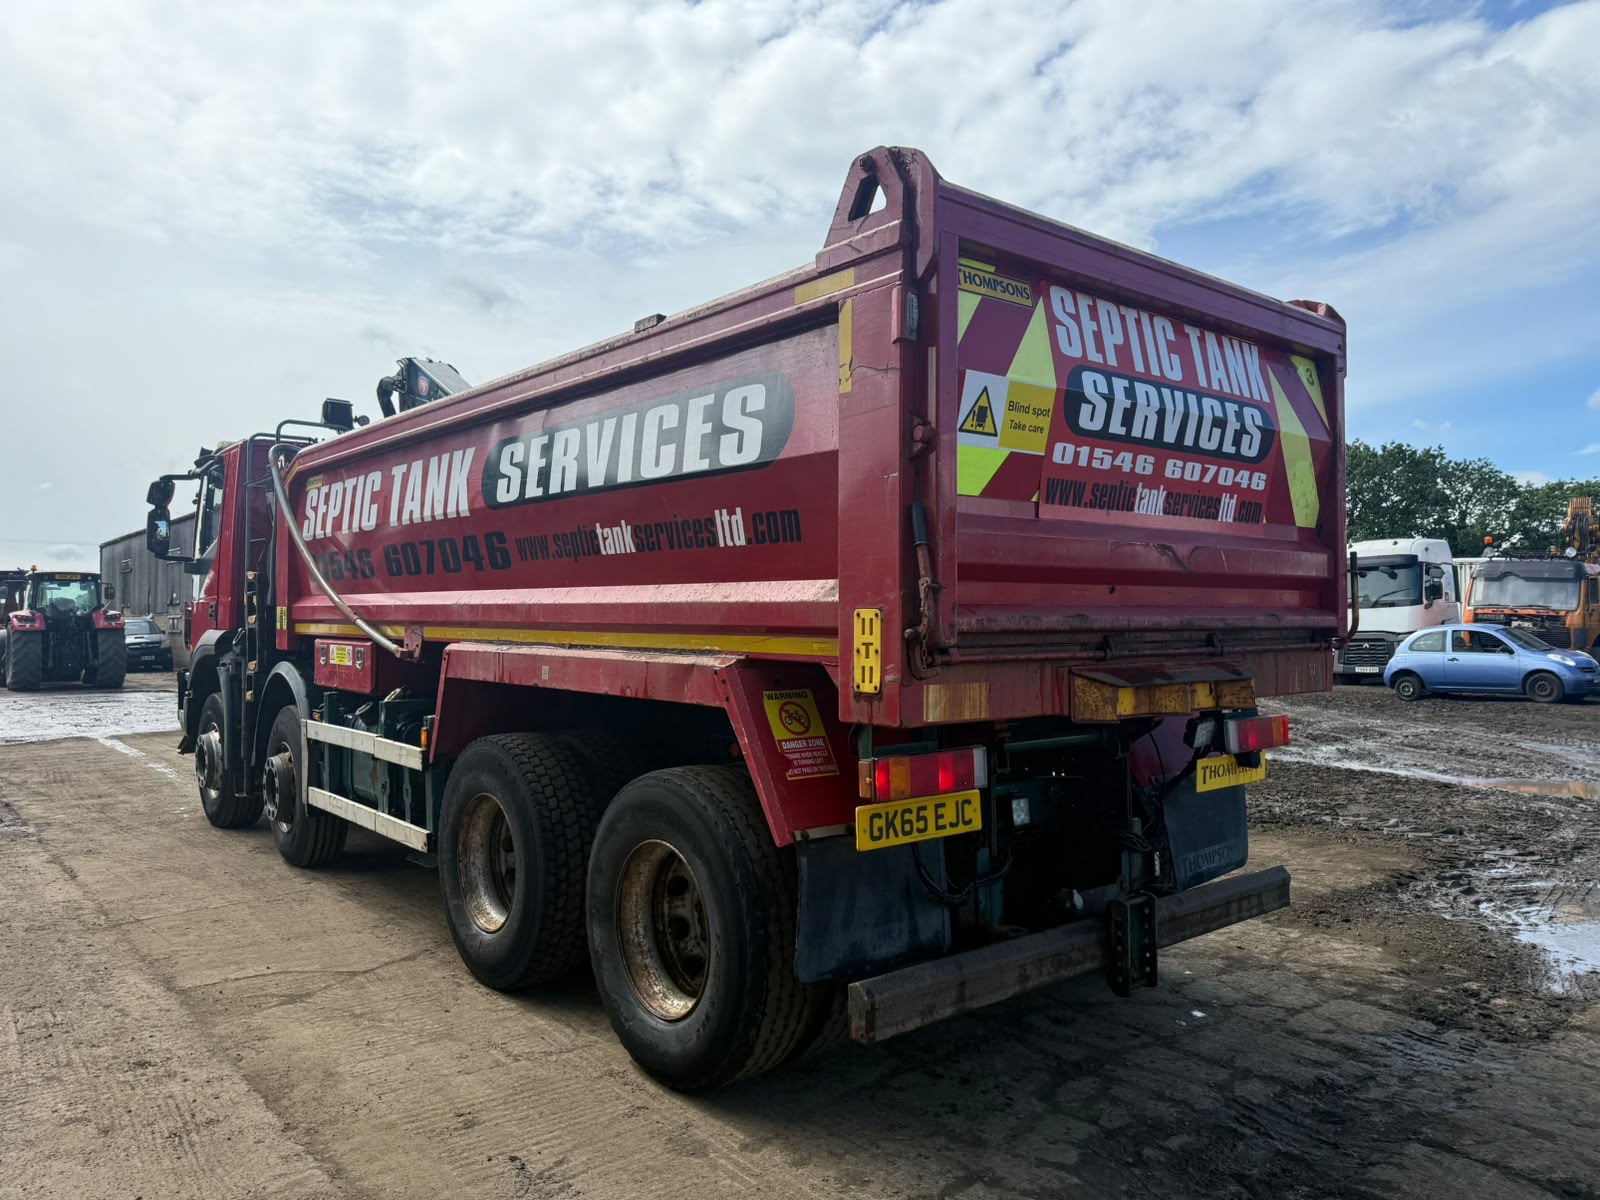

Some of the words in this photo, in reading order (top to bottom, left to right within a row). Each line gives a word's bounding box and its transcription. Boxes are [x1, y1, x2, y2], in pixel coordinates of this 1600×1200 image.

[1049, 285, 1183, 382] SEPTIC
[1183, 324, 1271, 403] TANK
[1007, 400, 1031, 414] Blind
[1032, 407, 1051, 419] spot
[1009, 419, 1027, 432] Take
[1028, 424, 1045, 434] care
[1078, 370, 1264, 458] SERVICES
[496, 383, 766, 503] SERVICES
[1052, 442, 1156, 476] 01546
[1164, 458, 1268, 491] 607046
[302, 470, 382, 541] SEPTIC
[389, 446, 476, 527] TANK
[1045, 477, 1263, 525] www.septictankservicesltd.com
[383, 530, 512, 577] 607046
[515, 506, 802, 563] www.septictankservicesltd.com
[765, 690, 808, 701] WARNING
[781, 739, 807, 750] DANGER
[808, 738, 825, 747] ZONE
[869, 805, 929, 842] GK65
[934, 798, 973, 831] EJC
